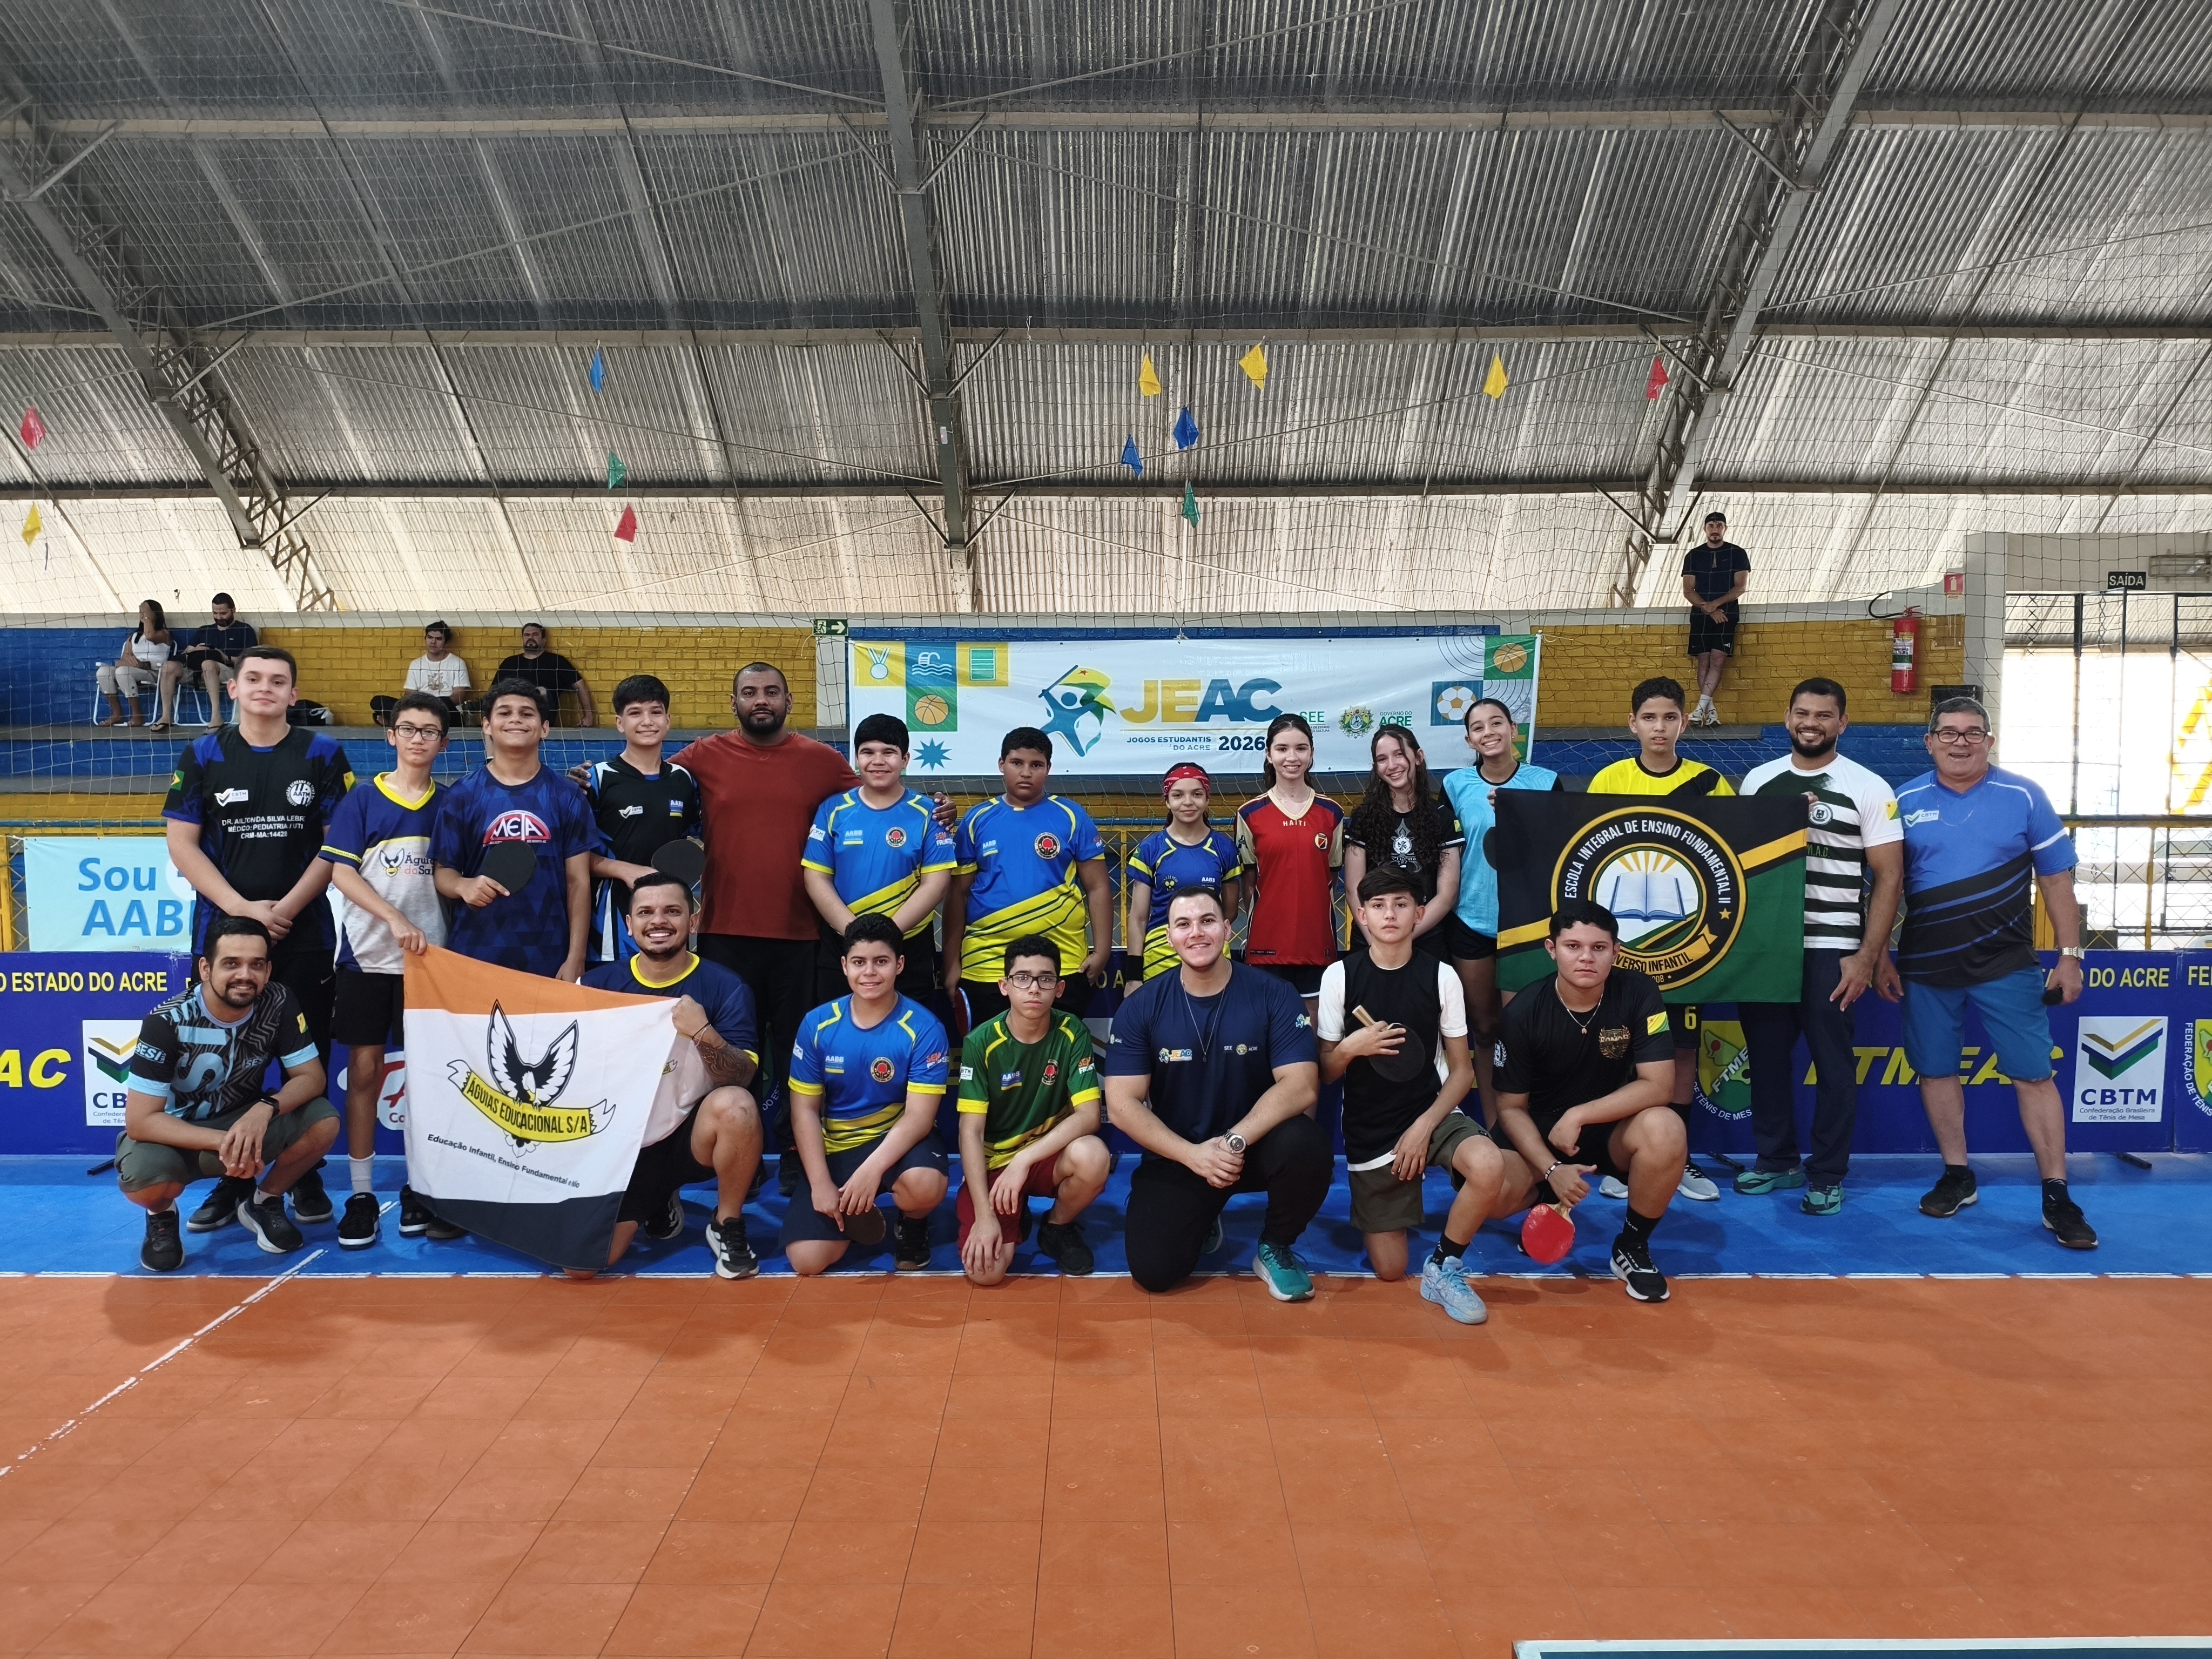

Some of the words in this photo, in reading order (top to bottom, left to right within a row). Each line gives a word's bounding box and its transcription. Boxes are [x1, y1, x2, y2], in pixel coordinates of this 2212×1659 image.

[2109, 572, 2144, 586] SAÍDA
[1120, 678, 1283, 723] JEAC
[1379, 716, 1412, 726] ACRE
[1218, 736, 1266, 751] 2026
[490, 814, 543, 841] META
[1564, 861, 1584, 898] ESCOLA
[1577, 825, 1624, 860] INTEGRAL
[1624, 820, 1639, 833] DE
[1642, 820, 1681, 838] ENSINO
[1681, 830, 1731, 895] FUNDAMENTAL
[78, 857, 156, 891] Sou
[1615, 954, 1647, 973] VERSO
[1649, 952, 1694, 972] INFANTIL
[12, 972, 84, 992] ESTADO
[89, 972, 114, 992] DO
[119, 972, 167, 992] ACRE
[2089, 968, 2115, 987] DO
[2119, 967, 2170, 987] ACRE
[1684, 1006, 1697, 1030] 6
[136, 1042, 162, 1061] SESI
[1170, 1049, 1192, 1058] JEAC
[2182, 1022, 2194, 1081] FEDERAÇÃO
[1711, 1047, 1749, 1093] FTME
[2081, 1089, 2156, 1105] CBTM
[2186, 1082, 2197, 1095] DE
[93, 1092, 127, 1108] CB
[467, 1077, 499, 1114] ÁGUIAS
[499, 1103, 564, 1133] EDUCACIONAL
[567, 1116, 587, 1133] S/A
[1696, 1093, 1718, 1114] TÊNIS
[1718, 1110, 1730, 1121] DE
[1732, 1109, 1752, 1121] MES
[2191, 1094, 2212, 1117] TÊNIS
[428, 1134, 467, 1151] Educação
[469, 1146, 496, 1163] Infantil,
[498, 1157, 520, 1171] Ensino
[521, 1165, 568, 1185] Fundamental
